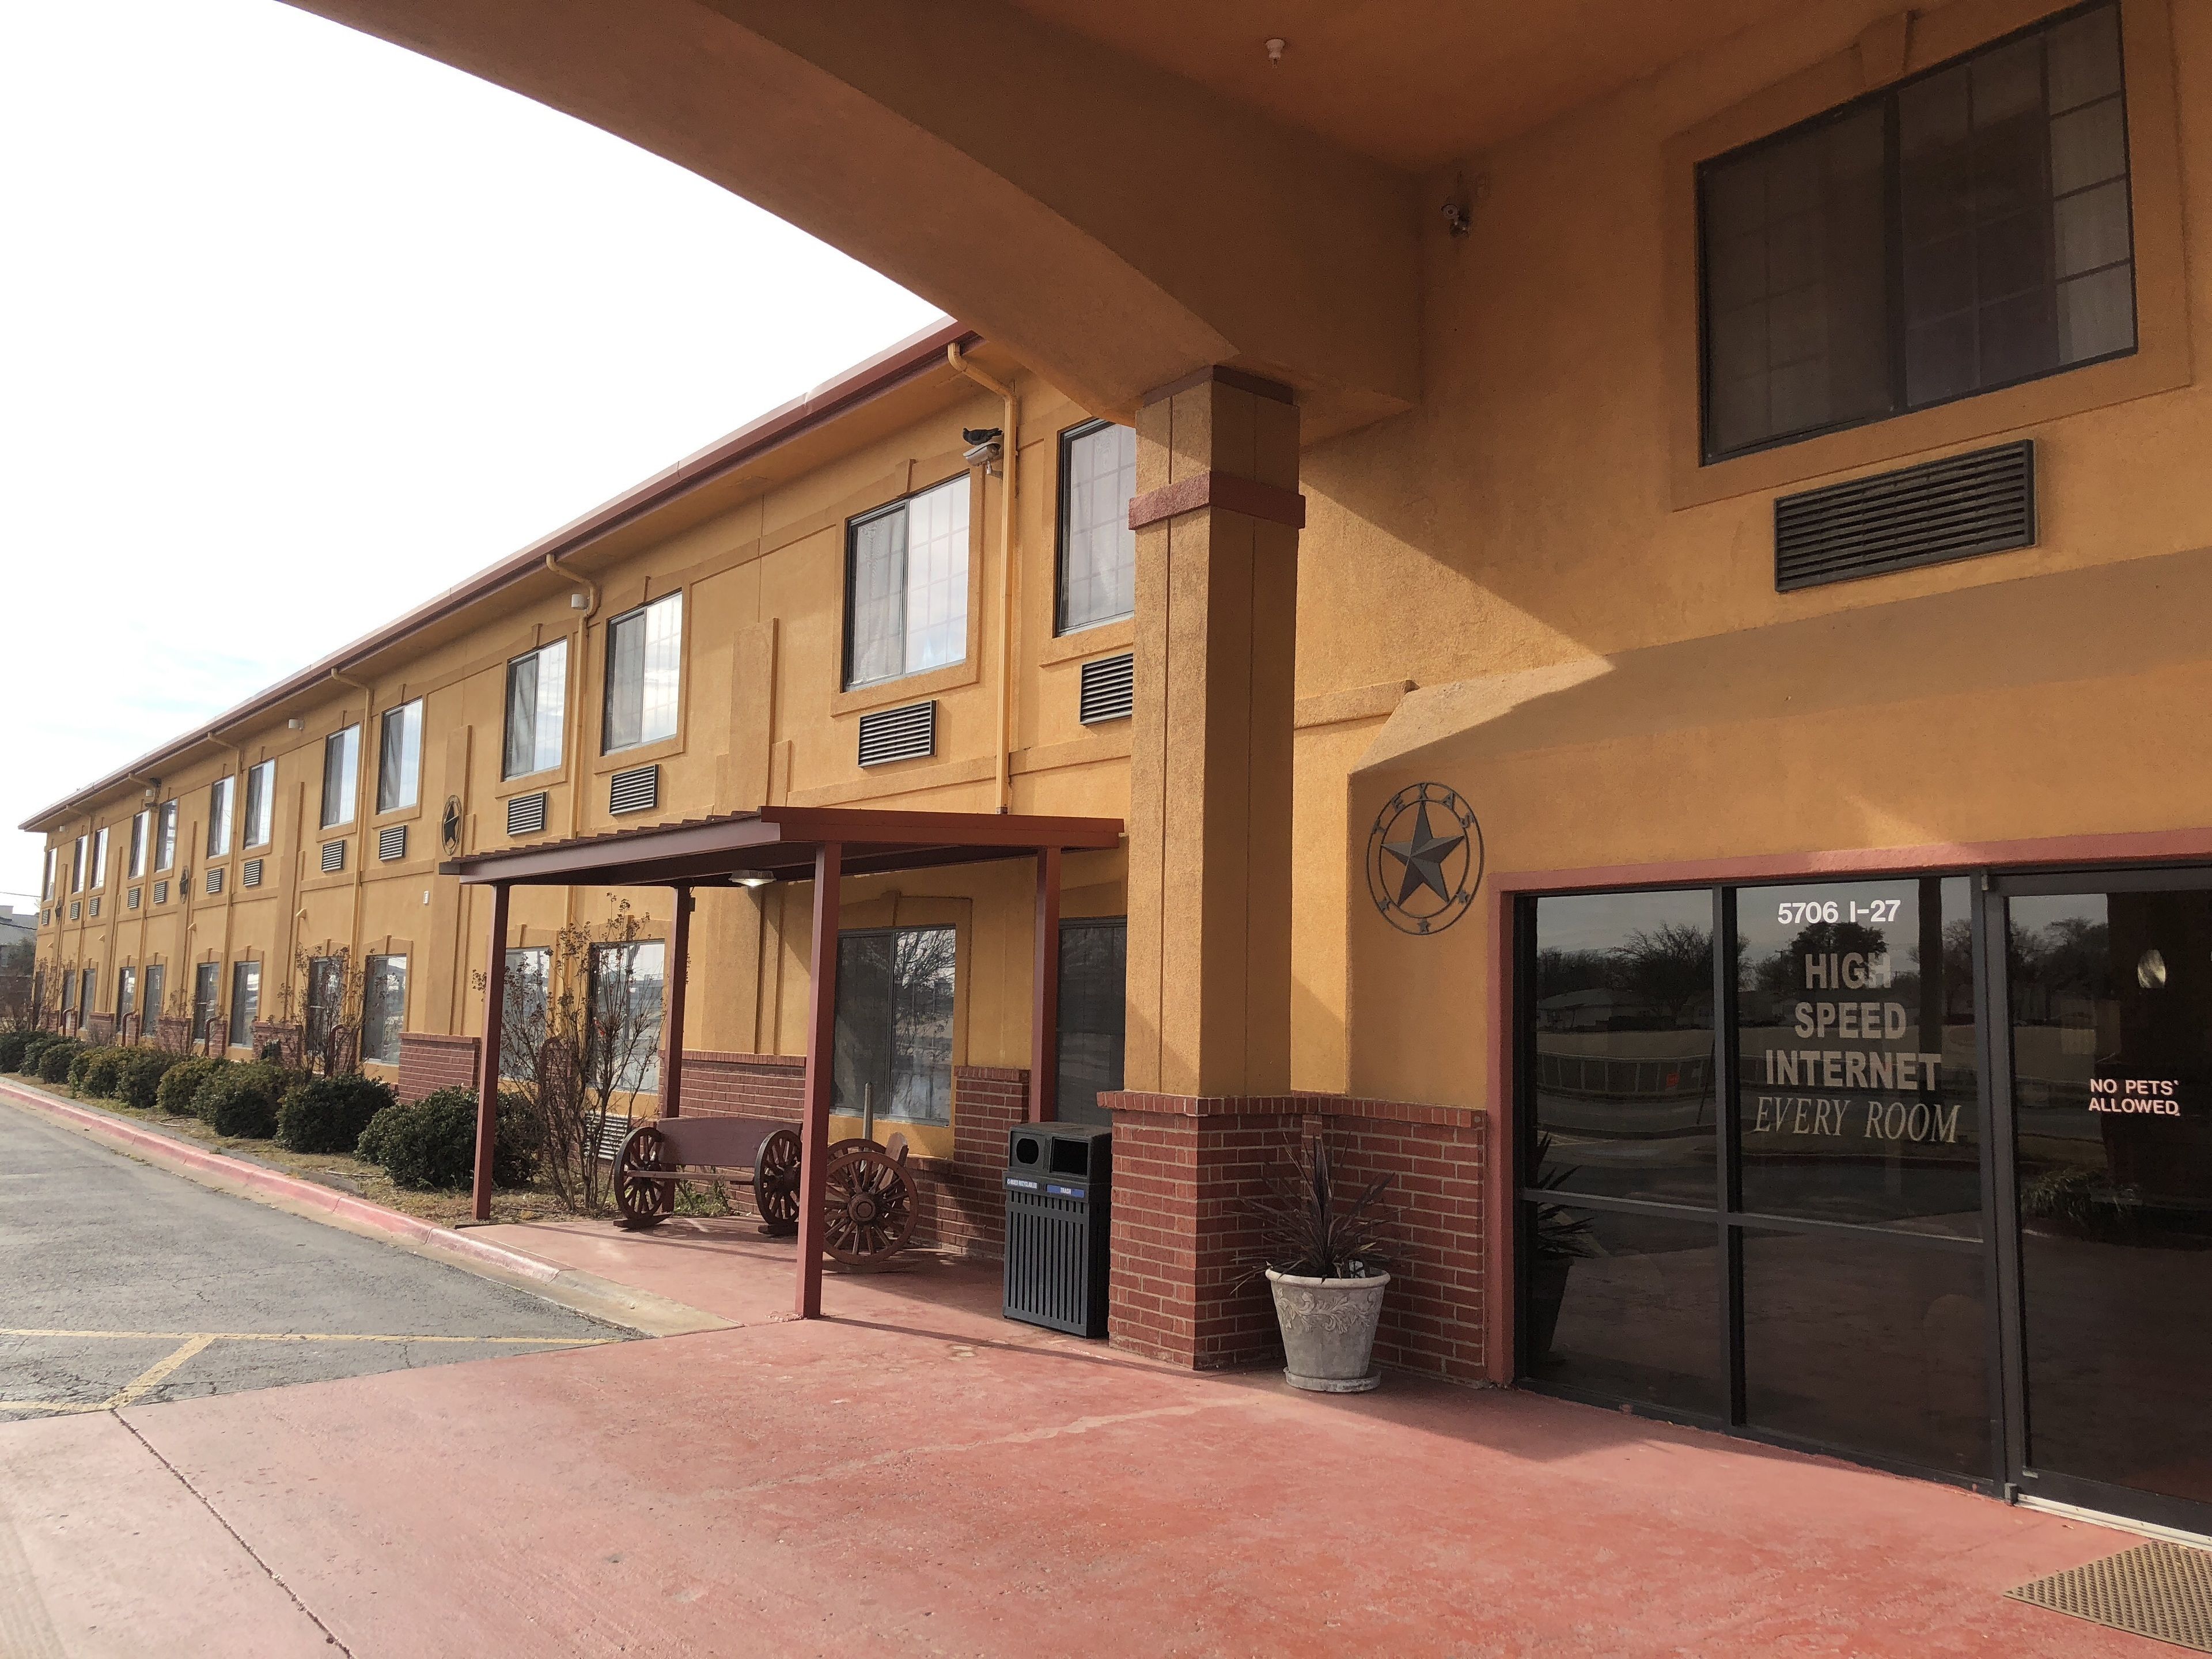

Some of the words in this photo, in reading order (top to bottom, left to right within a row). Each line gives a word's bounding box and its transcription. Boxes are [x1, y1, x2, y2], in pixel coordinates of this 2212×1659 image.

[1372, 783, 1475, 835] TEXAS
[1778, 901, 1839, 924] 5706
[1850, 899, 1901, 923] I-27
[1805, 952, 1892, 989] HIGH
[1794, 1001, 1906, 1039] SPEED
[1766, 1049, 1941, 1091] INTERNET
[2090, 1078, 2118, 1094] NO
[1755, 1096, 1851, 1136] EVERY
[1863, 1101, 1961, 1143] ROOM
[2088, 1097, 2180, 1116] ALLOWED
